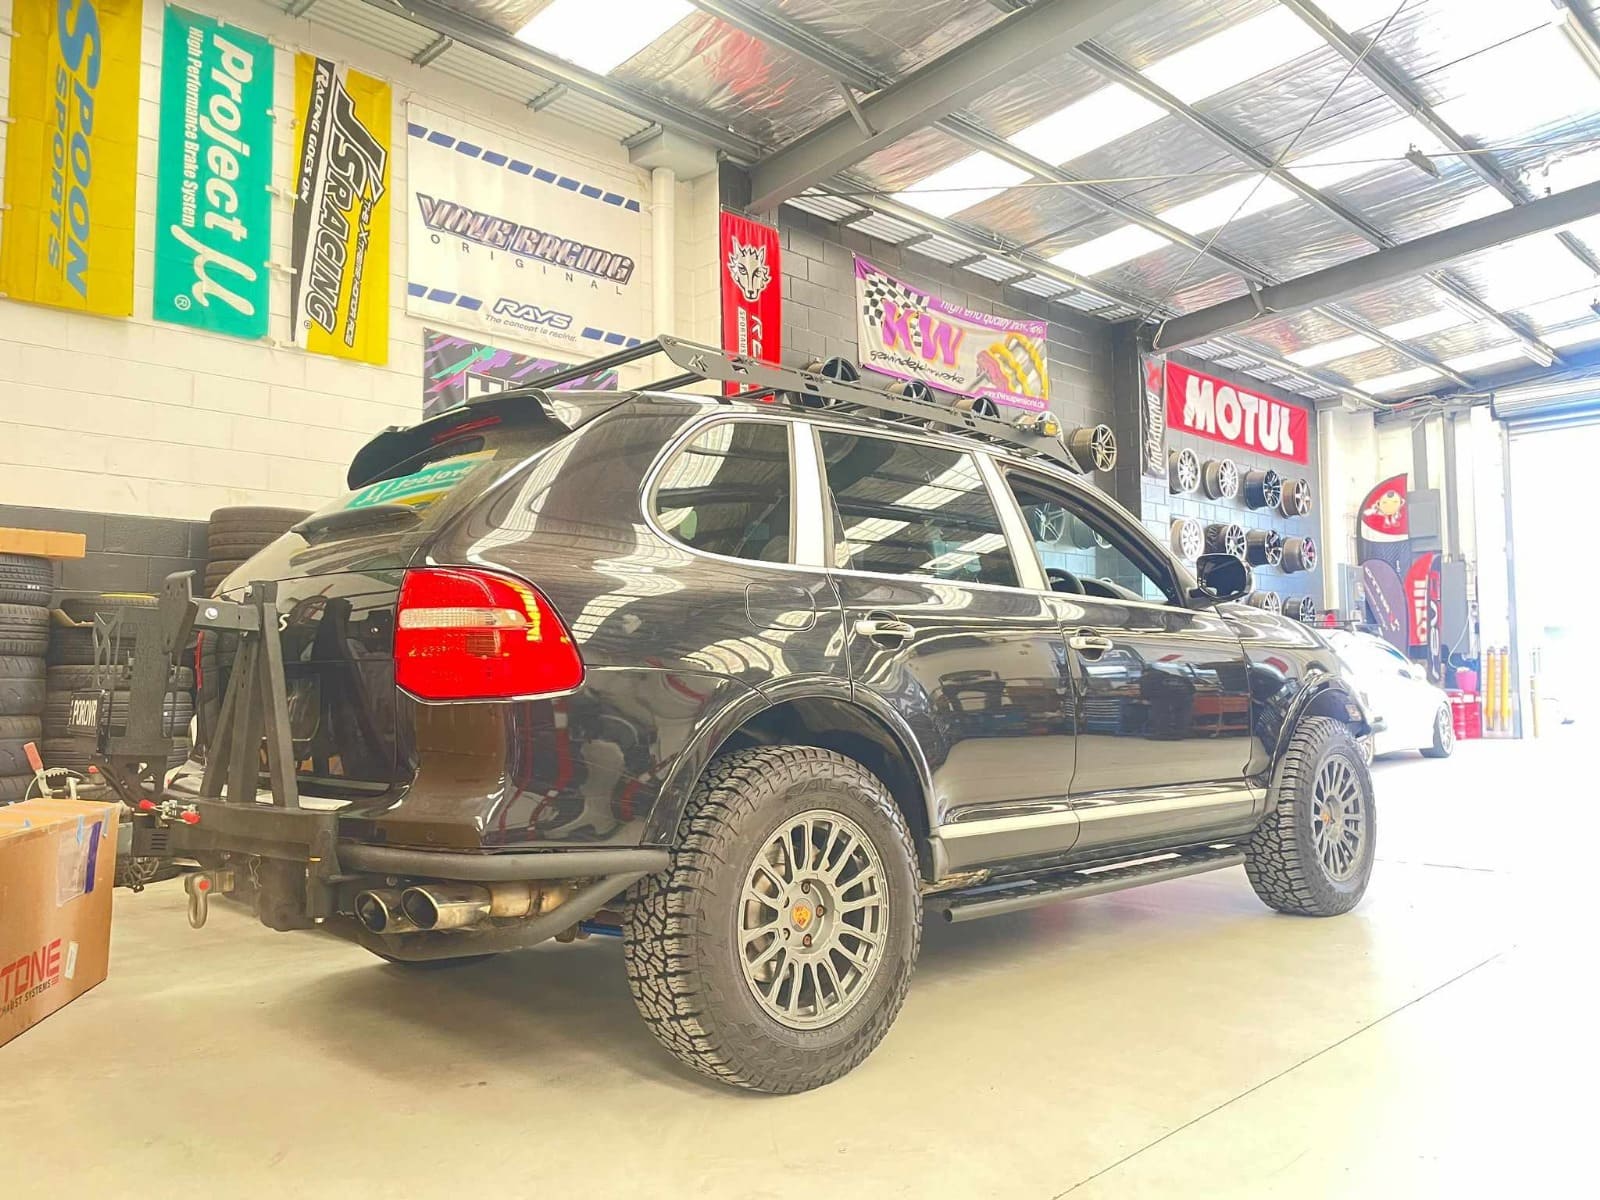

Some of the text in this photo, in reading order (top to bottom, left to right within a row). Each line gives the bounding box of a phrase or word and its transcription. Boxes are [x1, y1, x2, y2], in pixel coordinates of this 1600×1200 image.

[56, 0, 102, 298] SPOON
[181, 26, 204, 228] High Performance Brake System
[300, 63, 331, 204] RACING GOES ON
[47, 64, 67, 268] SPORTS
[430, 233, 624, 296] ORIGINAL
[509, 225, 636, 286] RACING
[485, 313, 502, 324] The
[503, 317, 539, 334] concept
[539, 325, 549, 335] is
[492, 297, 573, 329] RAYS
[881, 298, 966, 369] KW
[1183, 374, 1295, 456] MOTUL
